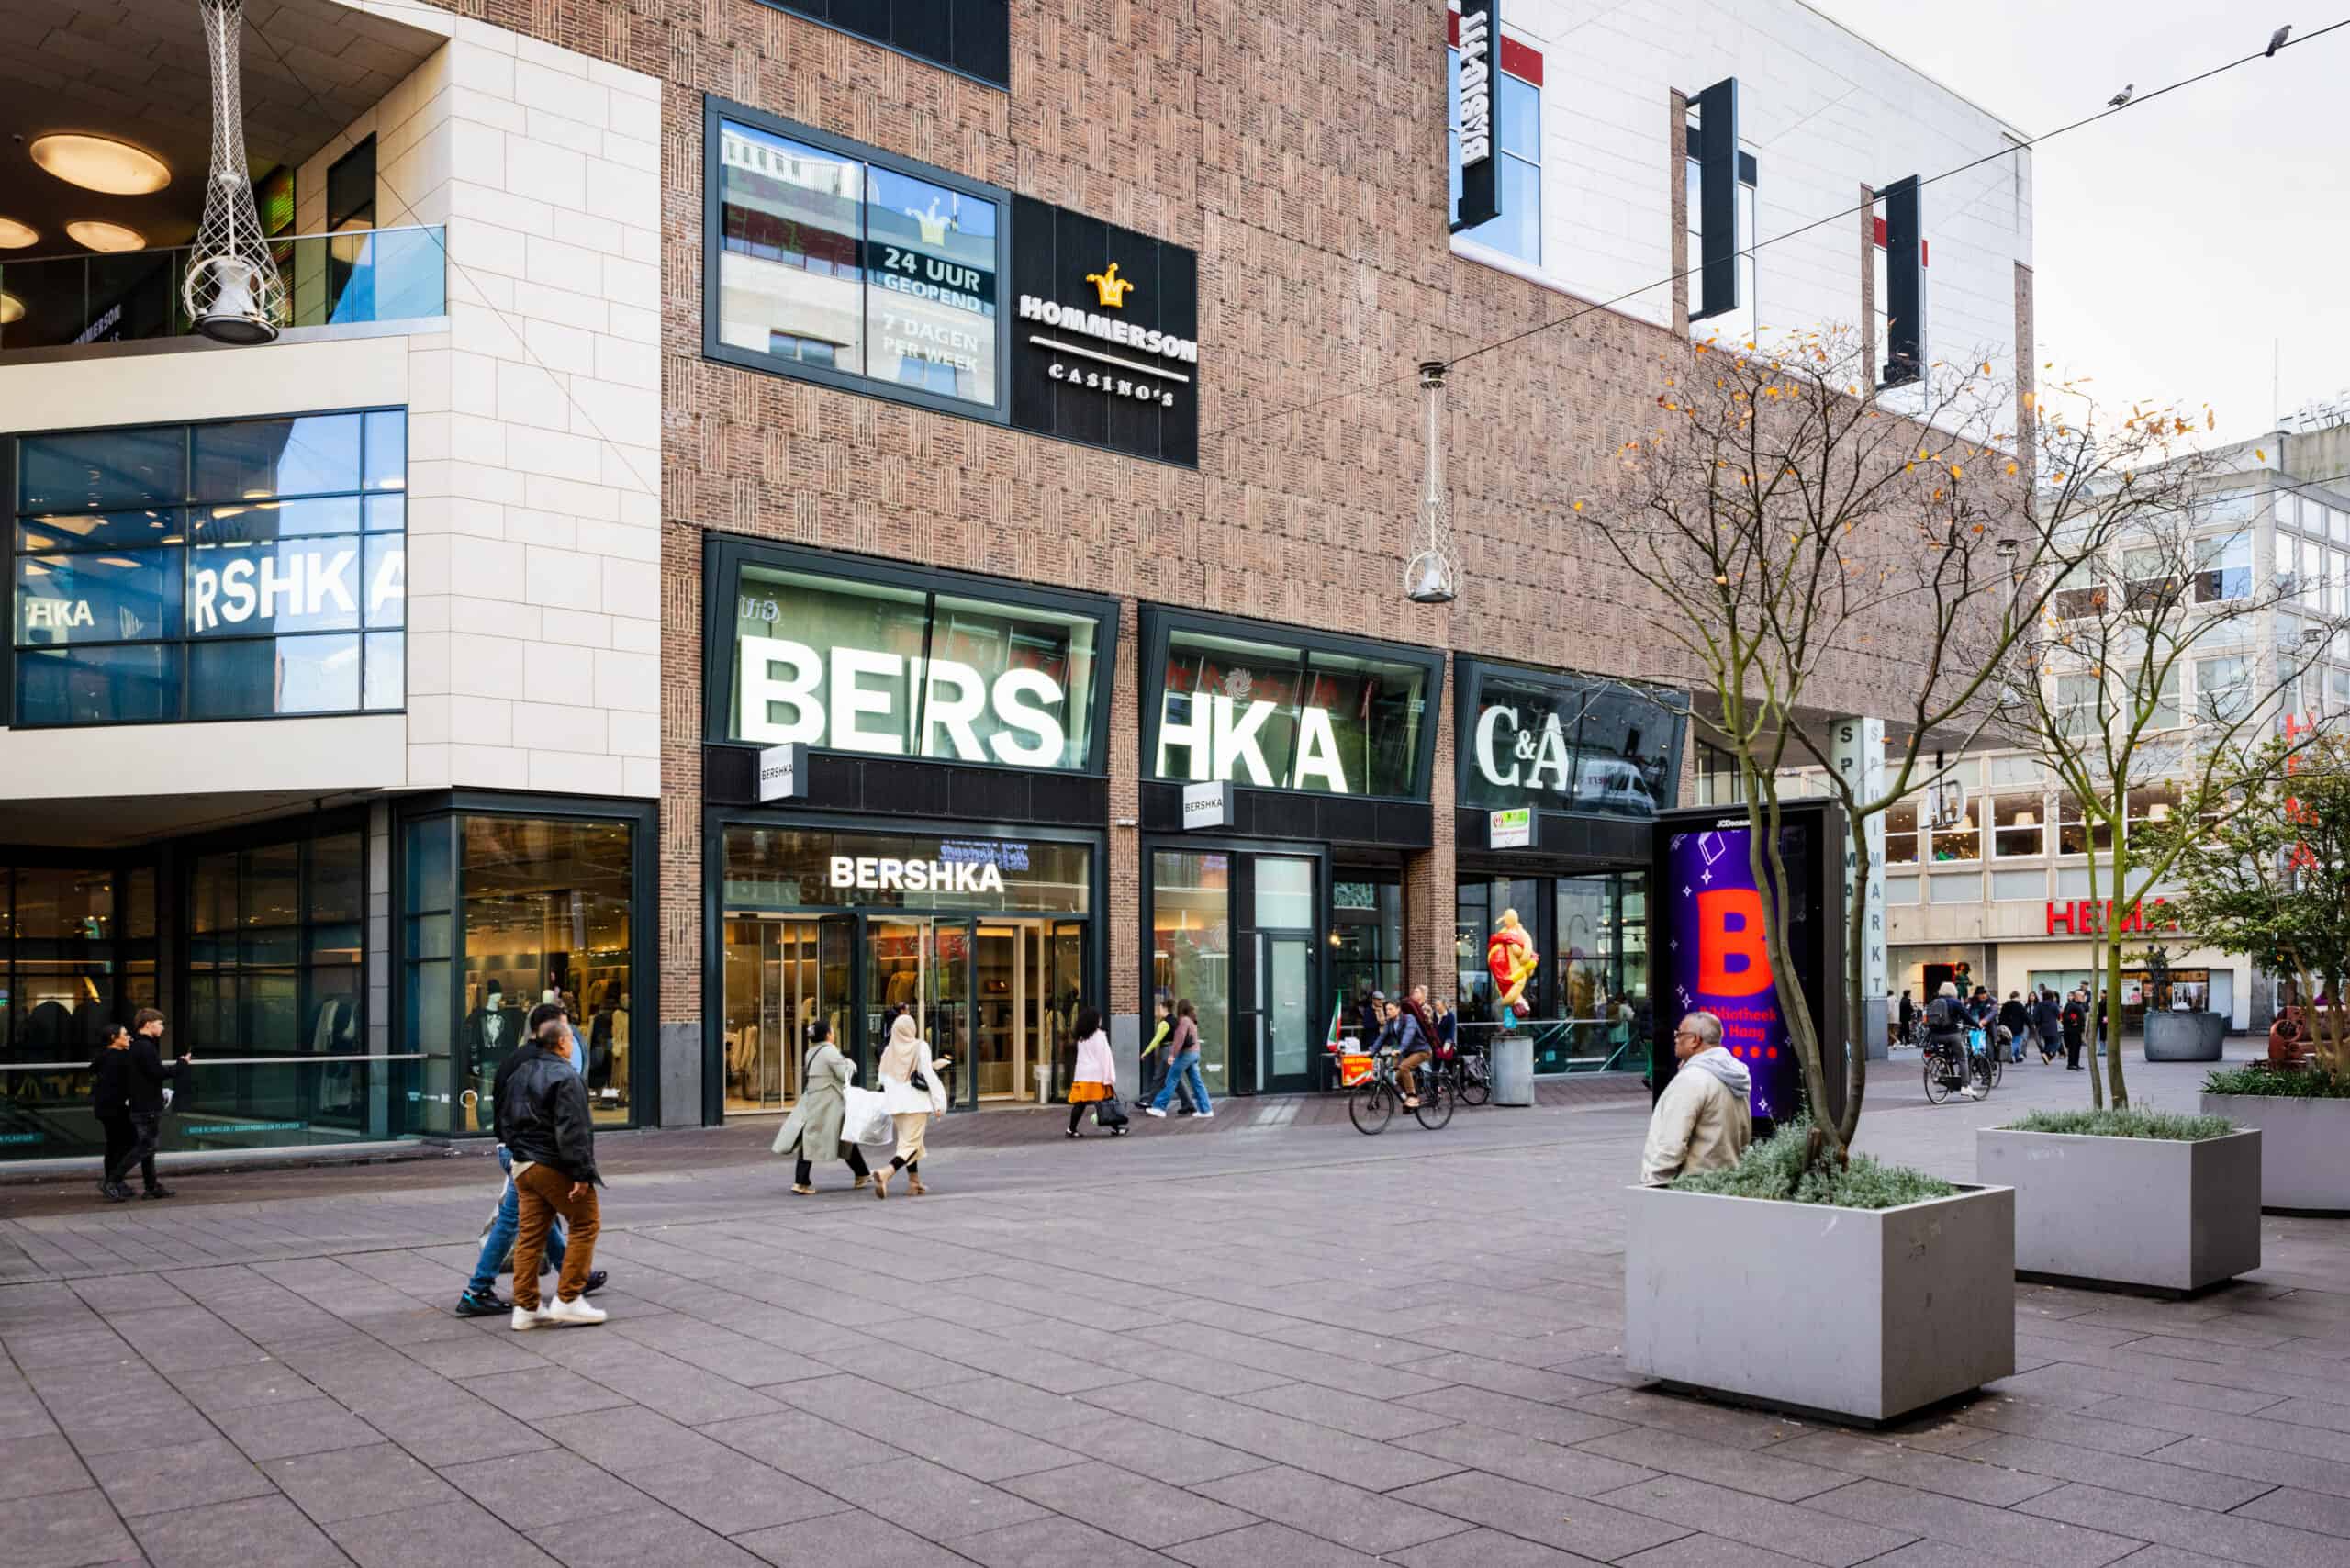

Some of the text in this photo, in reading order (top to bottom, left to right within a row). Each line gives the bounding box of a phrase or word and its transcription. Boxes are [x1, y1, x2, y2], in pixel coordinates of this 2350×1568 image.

[884, 247, 980, 292] 24 UUR
[884, 273, 980, 313] GEOPEND
[883, 313, 979, 353] 7 DAGEN
[1020, 294, 1198, 363] HOMMERSON
[883, 336, 978, 374] PER WEEK
[1048, 364, 1174, 407] CASINO'S
[1475, 705, 1570, 791] C&A
[761, 763, 794, 781] BERSHKA
[1184, 798, 1224, 813] BERSHKA
[829, 855, 1004, 893] BERSHKA
[1729, 1024, 1766, 1042] Haag
